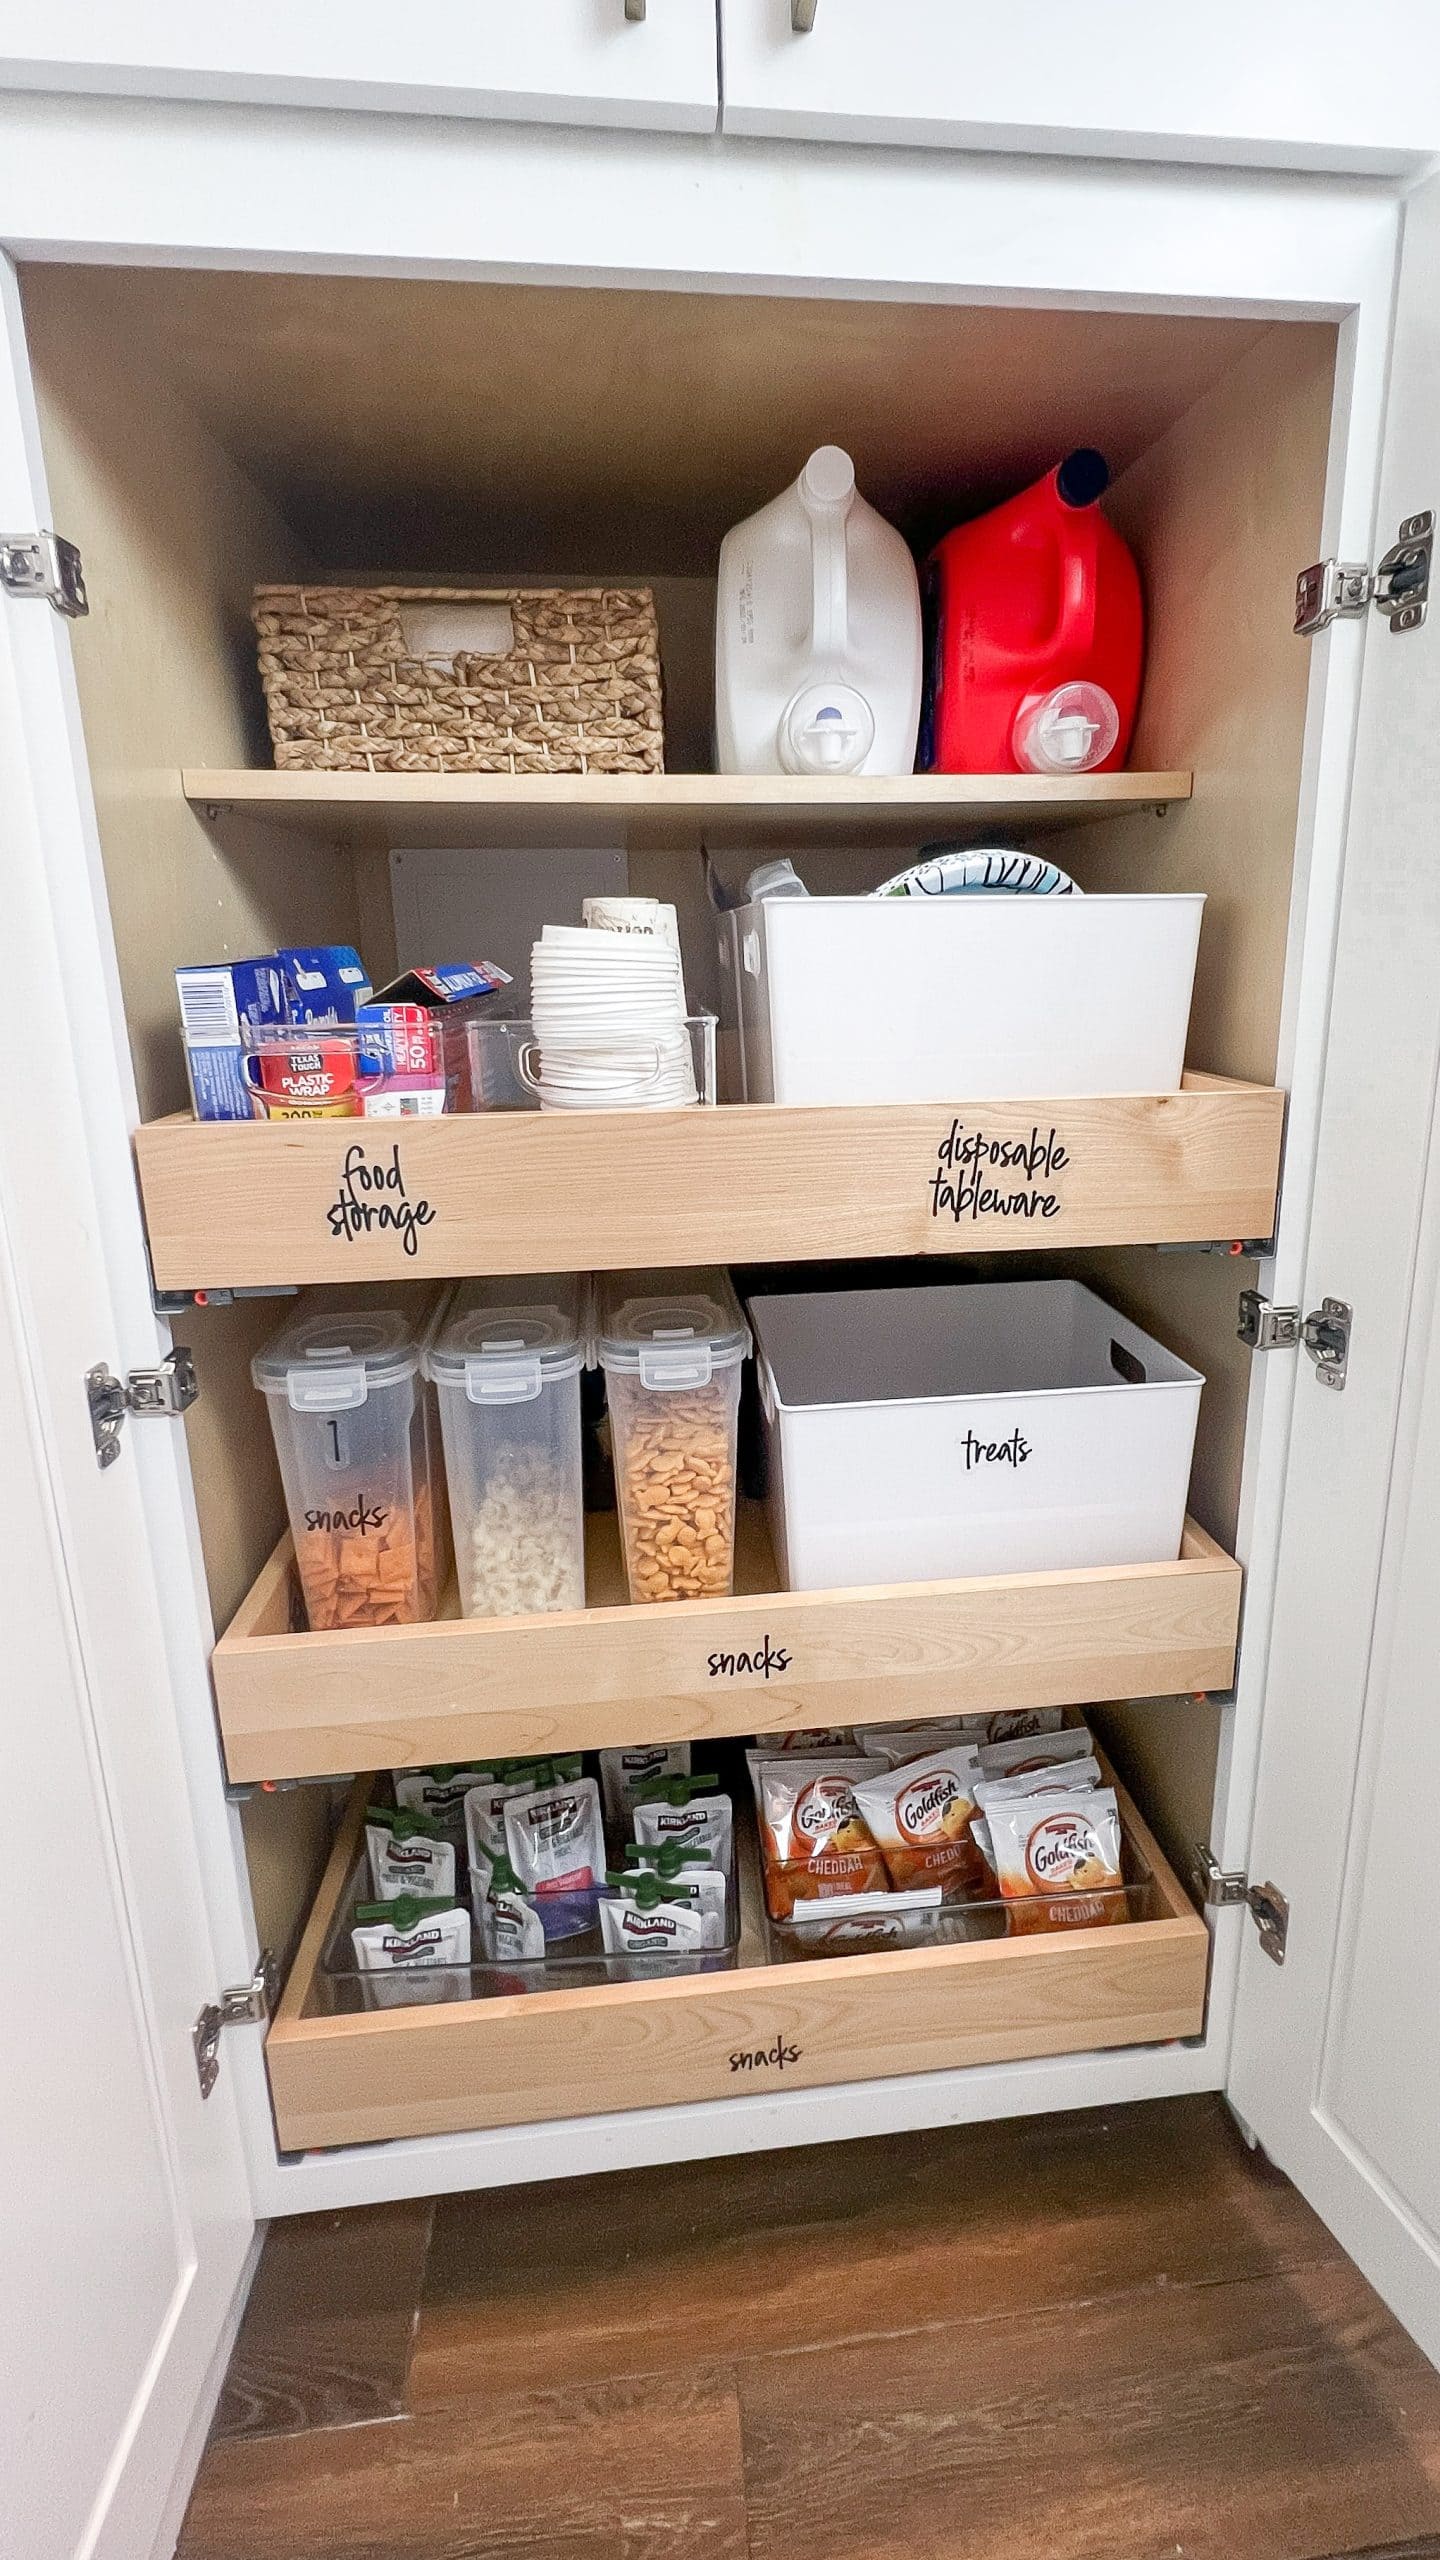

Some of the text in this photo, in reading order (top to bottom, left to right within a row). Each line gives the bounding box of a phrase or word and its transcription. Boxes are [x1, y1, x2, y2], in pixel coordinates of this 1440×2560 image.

[290, 1054, 319, 1064] TEXAS
[290, 1062, 322, 1072] TOUGH
[409, 1046, 426, 1069] 50
[281, 1073, 335, 1089] PLASTIC
[288, 1084, 330, 1097] WRAP
[938, 1118, 1071, 1186] disposable
[341, 1144, 406, 1206] food
[928, 1166, 1061, 1223] tableware
[326, 1189, 437, 1256] storage
[960, 1427, 1033, 1470] treats
[304, 1493, 389, 1536] snacks
[707, 1634, 793, 1679] snacks
[905, 1779, 958, 1829] Goldfish
[808, 1857, 864, 1875] CHEDDAR
[1049, 1900, 1106, 1922] CHEDDAR
[728, 2034, 804, 2073] snacks
